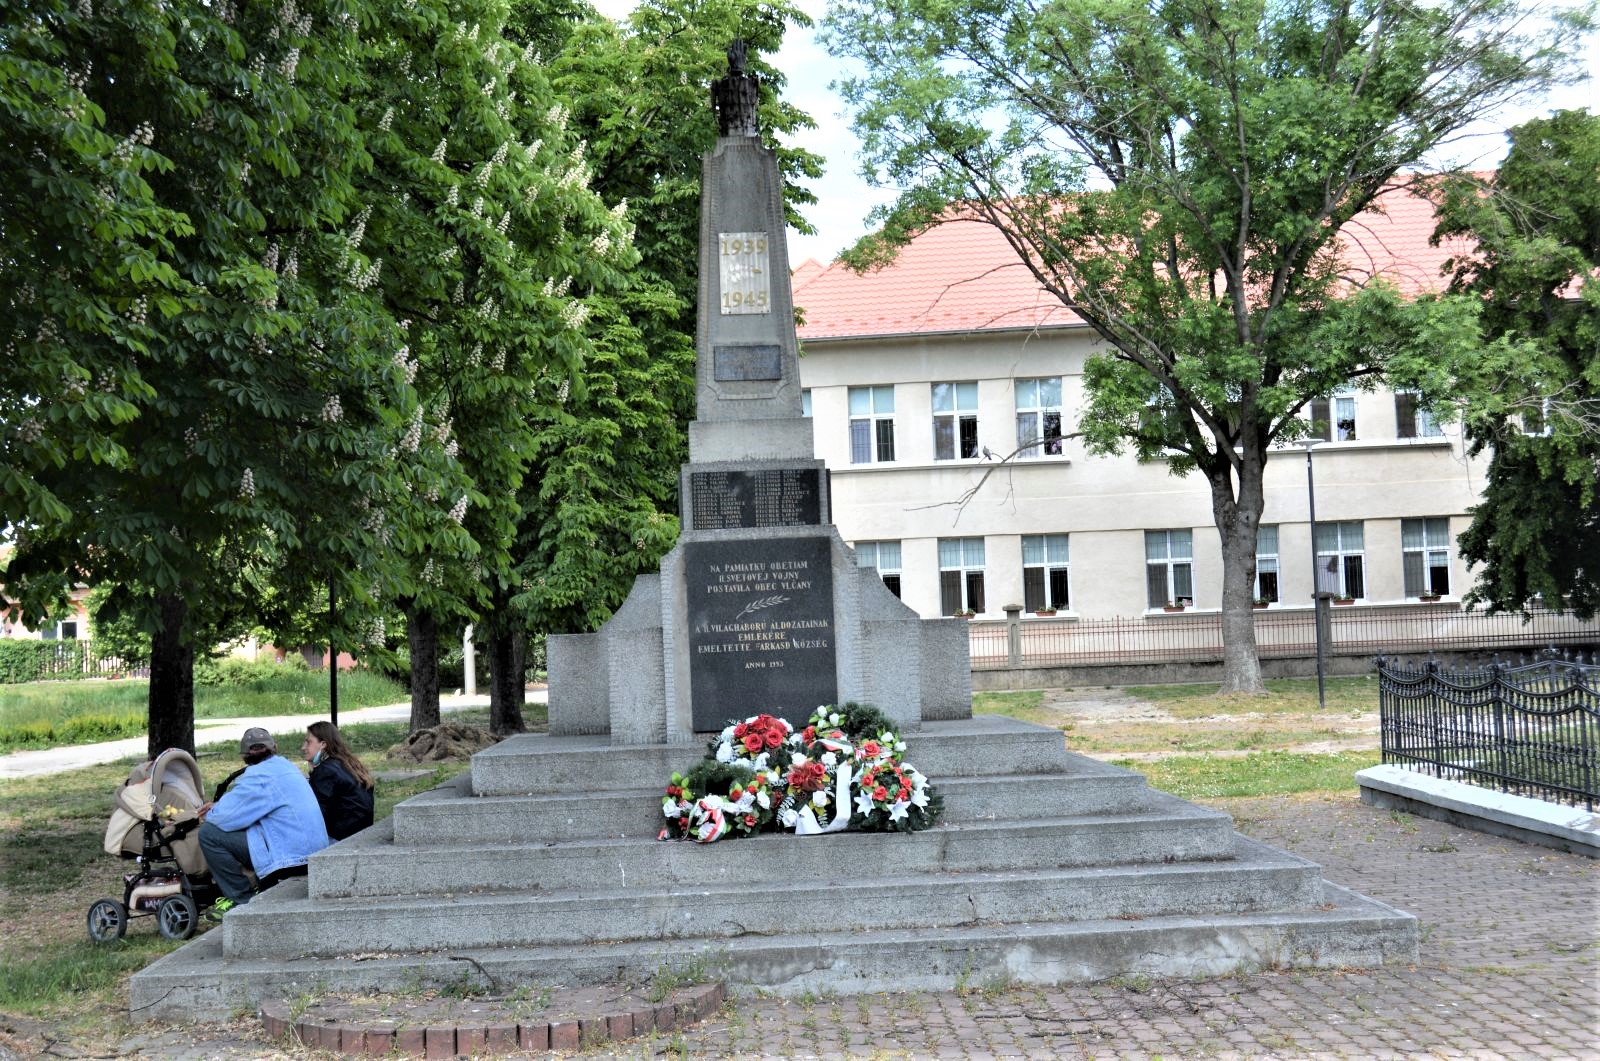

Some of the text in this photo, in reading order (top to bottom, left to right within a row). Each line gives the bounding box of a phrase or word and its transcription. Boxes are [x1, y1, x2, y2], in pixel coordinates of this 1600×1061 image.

[722, 239, 768, 256] 1939
[723, 291, 768, 308] 1945
[710, 561, 808, 573] NA PAMIATKU OBETIAM
[773, 572, 799, 580] VOJNY
[707, 579, 812, 593] POSTAVILA OBEC VLČANY
[698, 643, 751, 653] EMELTETTE
